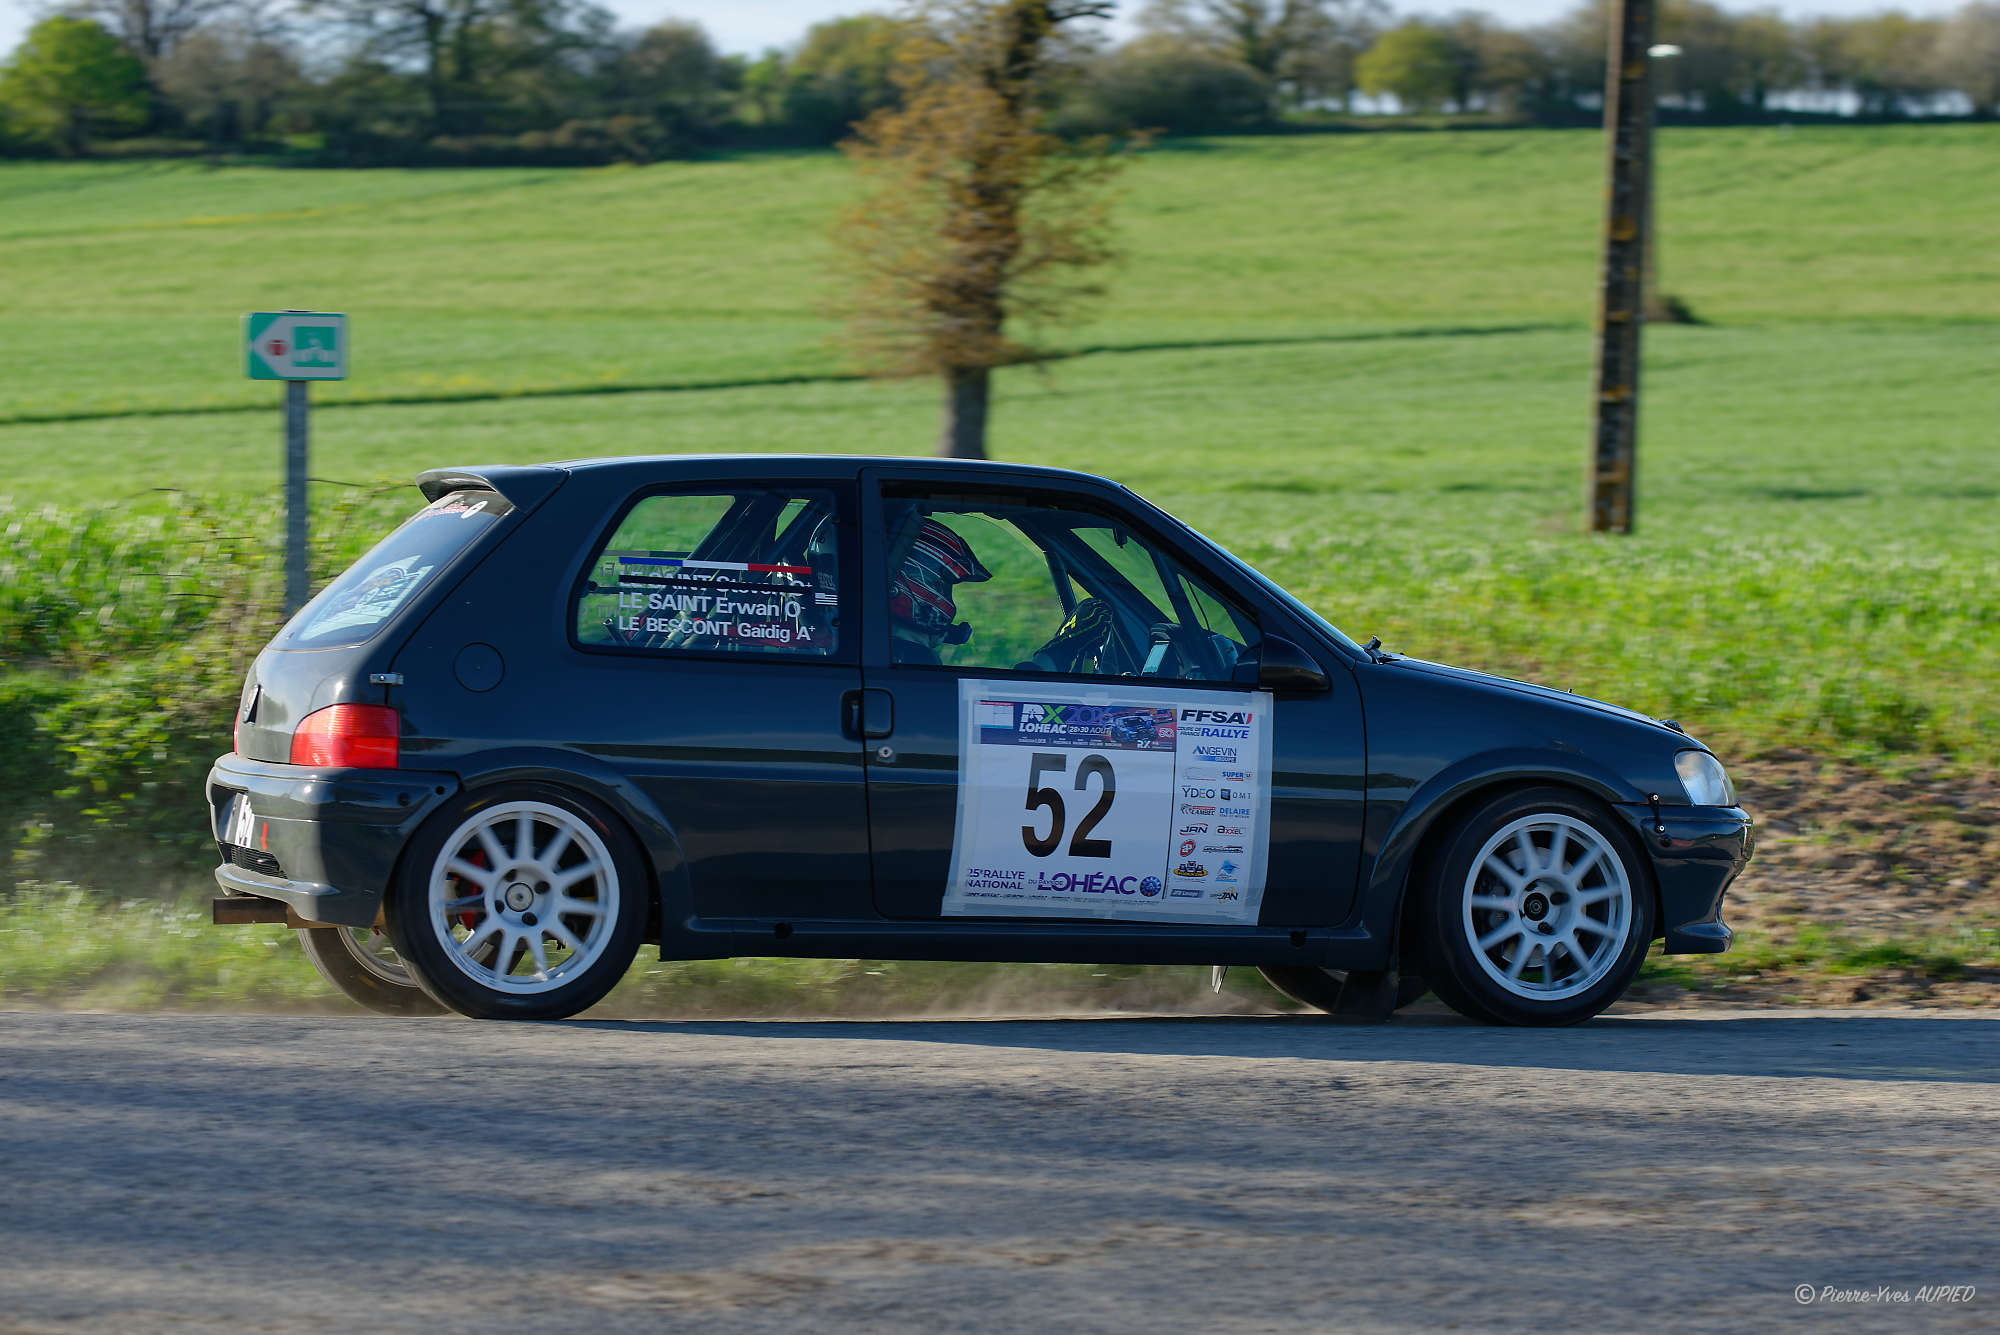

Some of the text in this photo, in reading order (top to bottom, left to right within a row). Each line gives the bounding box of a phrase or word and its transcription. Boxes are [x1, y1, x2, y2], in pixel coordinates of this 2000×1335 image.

[618, 591, 643, 609] LE
[648, 593, 712, 613] SAINT
[716, 596, 780, 616] Erwan
[618, 615, 640, 631] LE
[646, 617, 732, 635] BESCONT
[737, 622, 791, 643] Gaïdig
[1180, 709, 1245, 724] FFSA
[1019, 722, 1067, 734] LOHEAC
[1201, 727, 1249, 739] RALLYE
[1192, 745, 1237, 756] ANGEVIN
[1182, 787, 1216, 799] YDEO
[1021, 752, 1116, 858] 52
[1219, 807, 1251, 816] DELAIRE
[983, 869, 1025, 880] RALLYE
[966, 879, 1025, 890] NATIONAL
[1037, 870, 1138, 895] LOHÉAC
